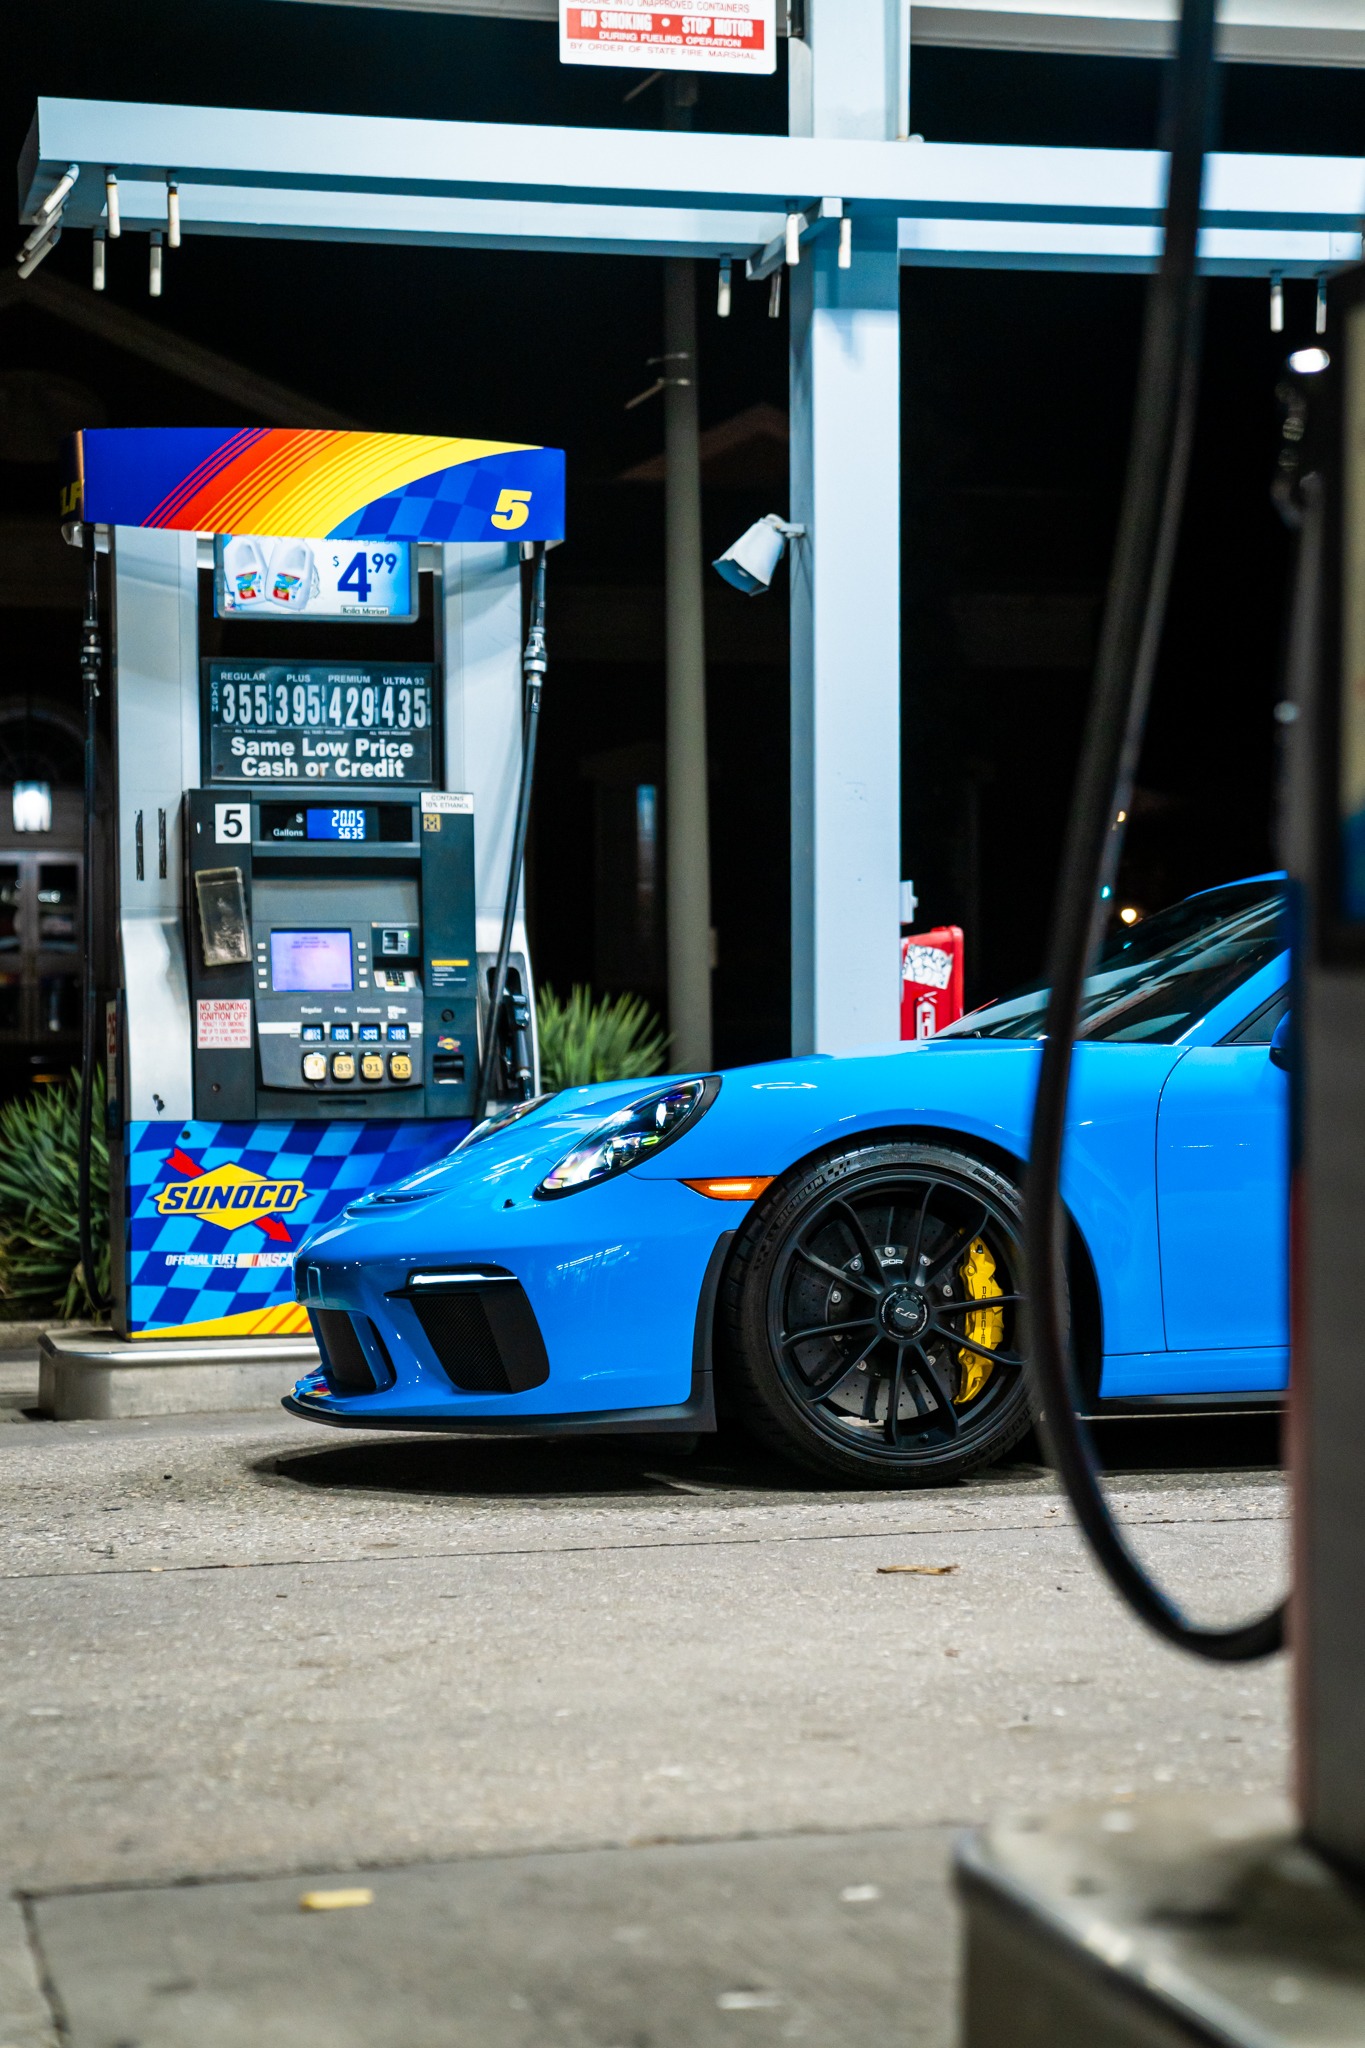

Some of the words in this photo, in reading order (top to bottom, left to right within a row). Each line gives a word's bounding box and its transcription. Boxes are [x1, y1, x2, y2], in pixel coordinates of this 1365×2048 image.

[637, 0, 693, 10] UNAPPROVED
[696, 2, 750, 14] CONTAINERS
[580, 10, 597, 28] NO
[600, 11, 652, 31] SMOKING
[681, 16, 712, 35] STOP
[713, 18, 753, 37] MOTOR
[598, 31, 638, 42] DURING
[640, 33, 683, 44] FUELING
[685, 36, 742, 48] OPERATION
[570, 41, 583, 50] BY
[588, 43, 624, 52] ORDER
[628, 45, 641, 53] OF
[647, 46, 676, 55] STATE
[681, 48, 703, 57] FIRE
[708, 50, 757, 60] MARSHAL
[491, 488, 532, 531] 5
[221, 672, 266, 681] REGULAR
[286, 674, 311, 682] PLUS
[328, 674, 371, 684] PREMIUM
[382, 676, 412, 685] ULTRA
[414, 677, 424, 686] 93
[211, 682, 219, 712] CASH
[231, 737, 295, 756] Same
[302, 738, 348, 757] Low
[355, 738, 414, 757] Price
[241, 757, 299, 776] Cash
[305, 763, 329, 777] or
[334, 758, 405, 777] Credit
[223, 809, 243, 838] 5
[273, 827, 304, 837] Gallons
[200, 1002, 211, 1011] NO
[214, 1002, 248, 1011] SMOKING
[200, 1011, 231, 1021] IGNITION
[233, 1011, 248, 1021] OFF
[337, 1063, 352, 1072] 89
[365, 1063, 380, 1072] 91
[394, 1063, 409, 1072] 93
[163, 1184, 299, 1210] SUNOCO
[775, 1174, 826, 1227] MICHELIN
[165, 1254, 209, 1267] OFFICIAL
[211, 1253, 236, 1266] FUEL
[258, 1252, 294, 1267] NASCA
[895, 1307, 919, 1320] GT3
